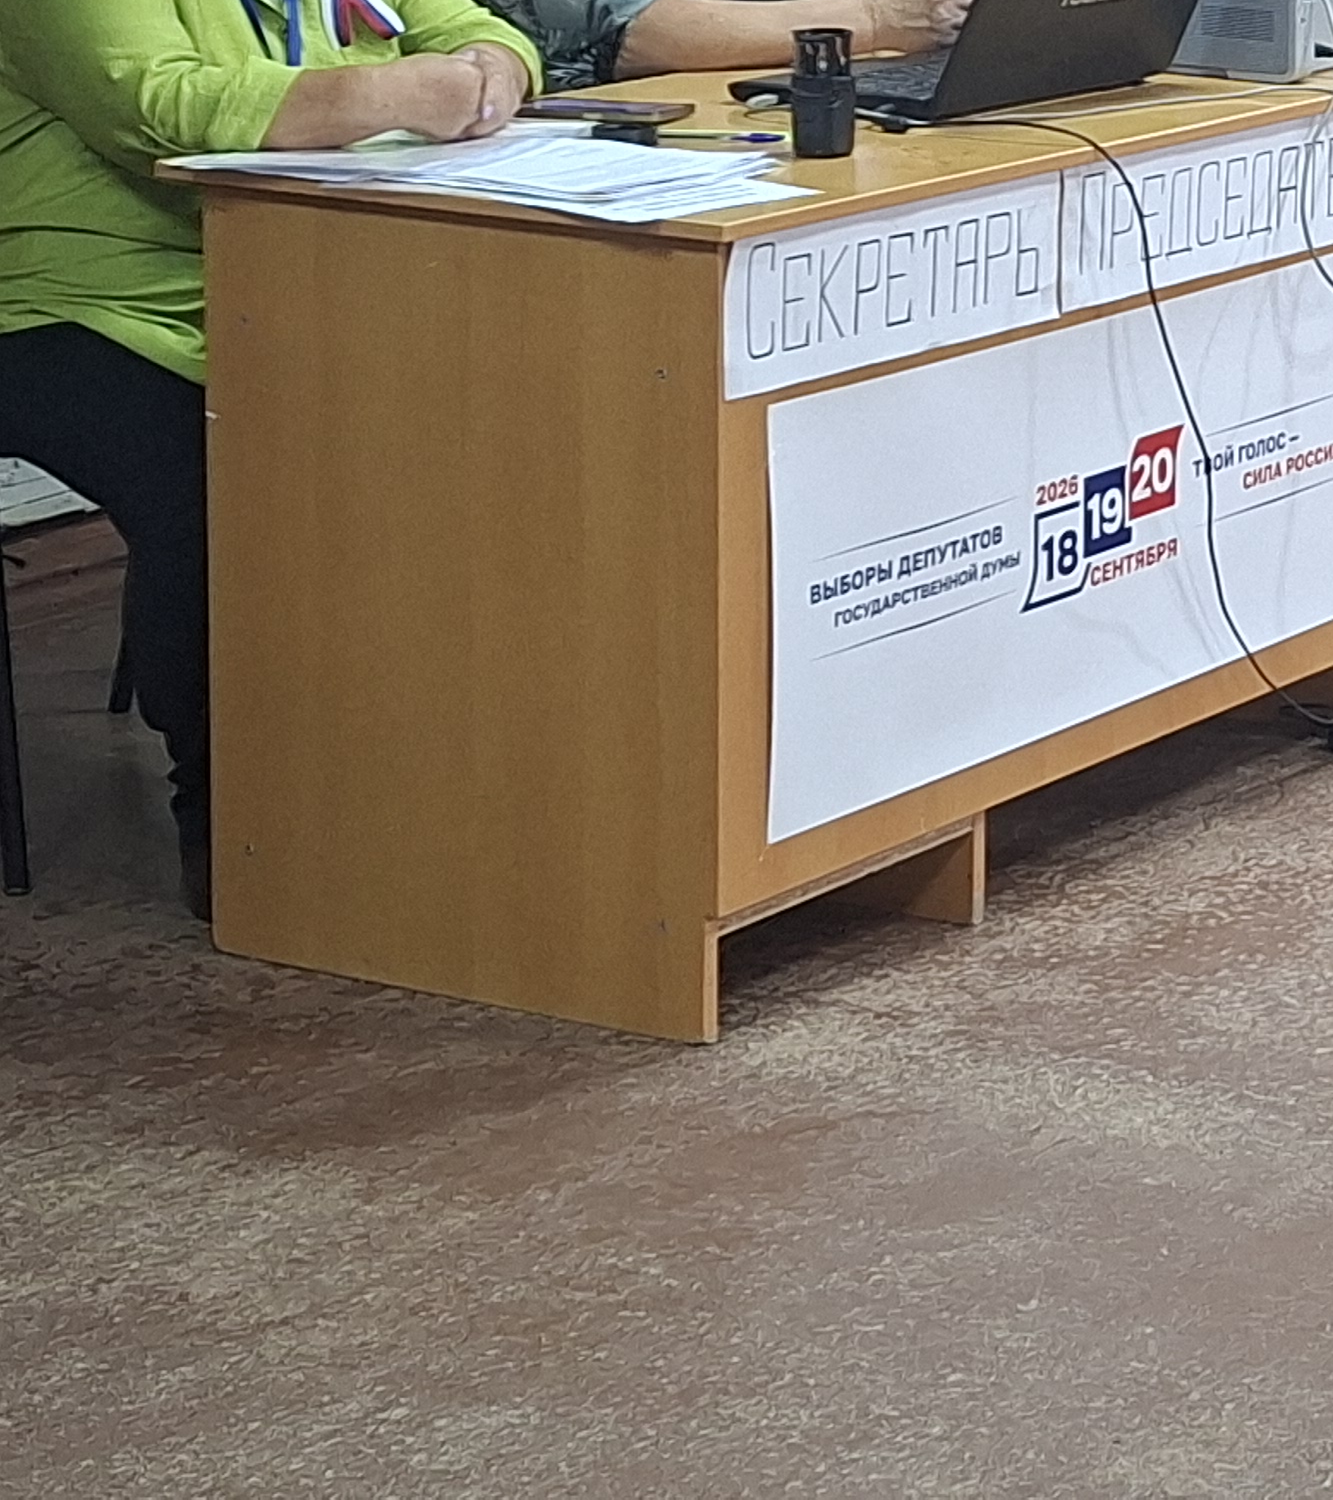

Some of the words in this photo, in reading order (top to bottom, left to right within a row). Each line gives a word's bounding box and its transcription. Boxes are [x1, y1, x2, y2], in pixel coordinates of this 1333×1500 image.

[746, 207, 1039, 360] СЕКРЕТАРЬ
[1238, 432, 1286, 463] ГОЛОС
[1243, 460, 1282, 490] СИЛА
[1036, 474, 1078, 506] 2026
[1041, 530, 1078, 582] 18
[1087, 487, 1123, 540] 19
[1131, 446, 1174, 502] 20
[810, 560, 893, 605] ВЫБОРЫ
[897, 526, 1003, 579] ДЕПУТАТОВ
[834, 563, 978, 628] ГОСУДАРСТВЕННОЙ
[980, 551, 1021, 582] ДУМЫ
[1090, 538, 1178, 587] СЕНТЯБРЯ
